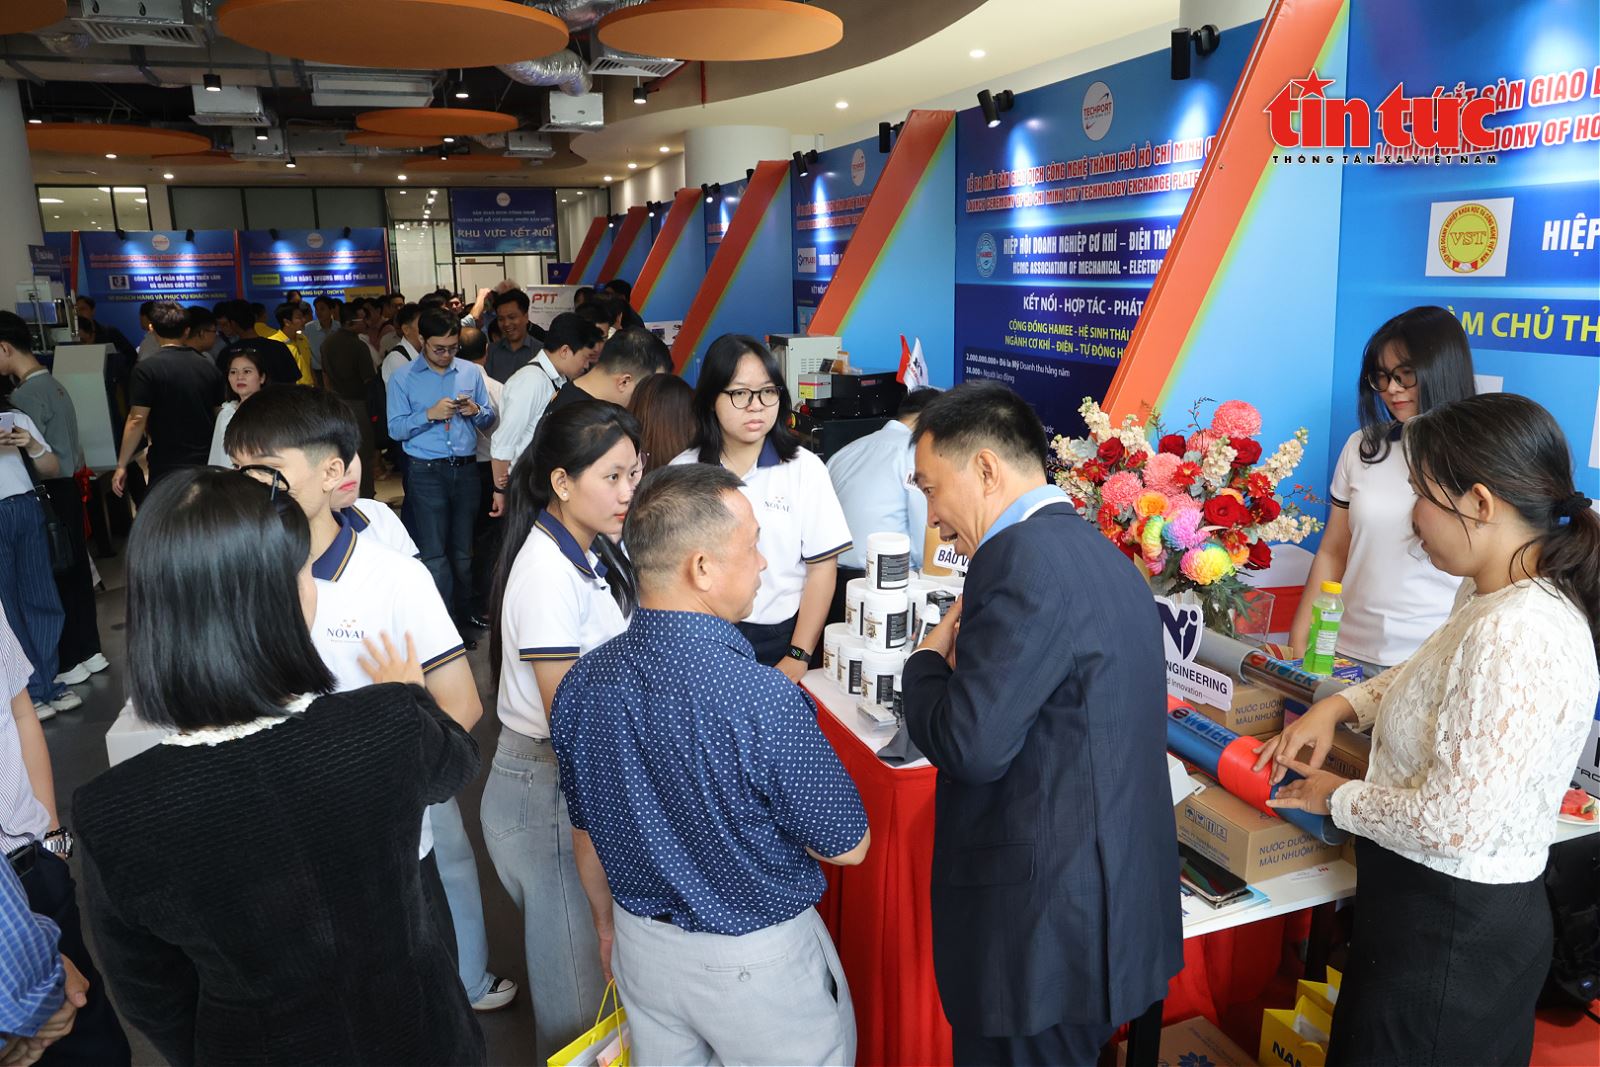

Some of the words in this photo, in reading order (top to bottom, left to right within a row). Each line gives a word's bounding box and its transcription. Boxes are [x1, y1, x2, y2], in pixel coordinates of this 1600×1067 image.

[1529, 68, 1587, 107] GIAO
[1084, 102, 1112, 117] TECHPORT
[1544, 119, 1571, 145] OF
[1027, 166, 1044, 187] DỊCH
[1045, 160, 1065, 182] CÔNG
[1066, 155, 1088, 180] NGHỆ
[1089, 152, 1116, 175] THÀNH
[1118, 143, 1136, 172] PHỐ
[1138, 140, 1152, 168] HỒ
[1153, 139, 1172, 165] CHÍ
[1173, 137, 1203, 163] MINH
[1033, 191, 1044, 206] CHI
[1045, 188, 1063, 204] MINH
[1065, 186, 1080, 203] CITY
[1080, 180, 1127, 201] TECHNOLOGY
[1127, 173, 1170, 196] EXCHANGE
[457, 229, 480, 238] KHU
[1003, 235, 1018, 258] HIỆP
[1019, 234, 1032, 257] HỘI
[1033, 236, 1057, 254] DOANH
[1058, 231, 1087, 256] NGHIỆP
[1089, 232, 1100, 252] CƠ
[1102, 228, 1117, 252] KHÍ
[1129, 226, 1151, 255] ĐIỆN
[1450, 231, 1487, 246] VST
[1542, 212, 1600, 257] HIỆP
[1030, 260, 1067, 275] ASSOCIATION
[1068, 260, 1077, 275] OF
[1078, 260, 1121, 274] MECHANICAL
[163, 293, 180, 301] PHỤC
[532, 293, 558, 303] PTT
[1023, 292, 1040, 310] KẾT
[1041, 293, 1057, 312] NỐI
[1064, 297, 1085, 317] HỢP
[1087, 296, 1106, 315] TÁC
[1114, 297, 1144, 316] PHÁT
[1009, 319, 1026, 333] CỘNG
[1027, 319, 1047, 334] ĐỒNG
[1048, 324, 1073, 336] HAMEE
[1078, 324, 1088, 340] HỆ
[1090, 326, 1108, 339] SINH
[1110, 326, 1130, 342] THÁI
[1491, 305, 1555, 340] CHỦ
[1004, 335, 1027, 348] NGÀNH
[1028, 337, 1038, 349] CƠ
[1039, 337, 1050, 351] KHÍ
[1056, 340, 1073, 355] ĐIỆN
[1080, 343, 1091, 358] TỰ
[1092, 343, 1115, 360] ĐỘNG
[1020, 361, 1035, 372] Doanh
[1036, 362, 1044, 373] thu
[938, 547, 958, 565] BẢO
[961, 555, 969, 567] V
[1165, 660, 1228, 695] NGINEERING
[1172, 679, 1203, 699] Innovation
